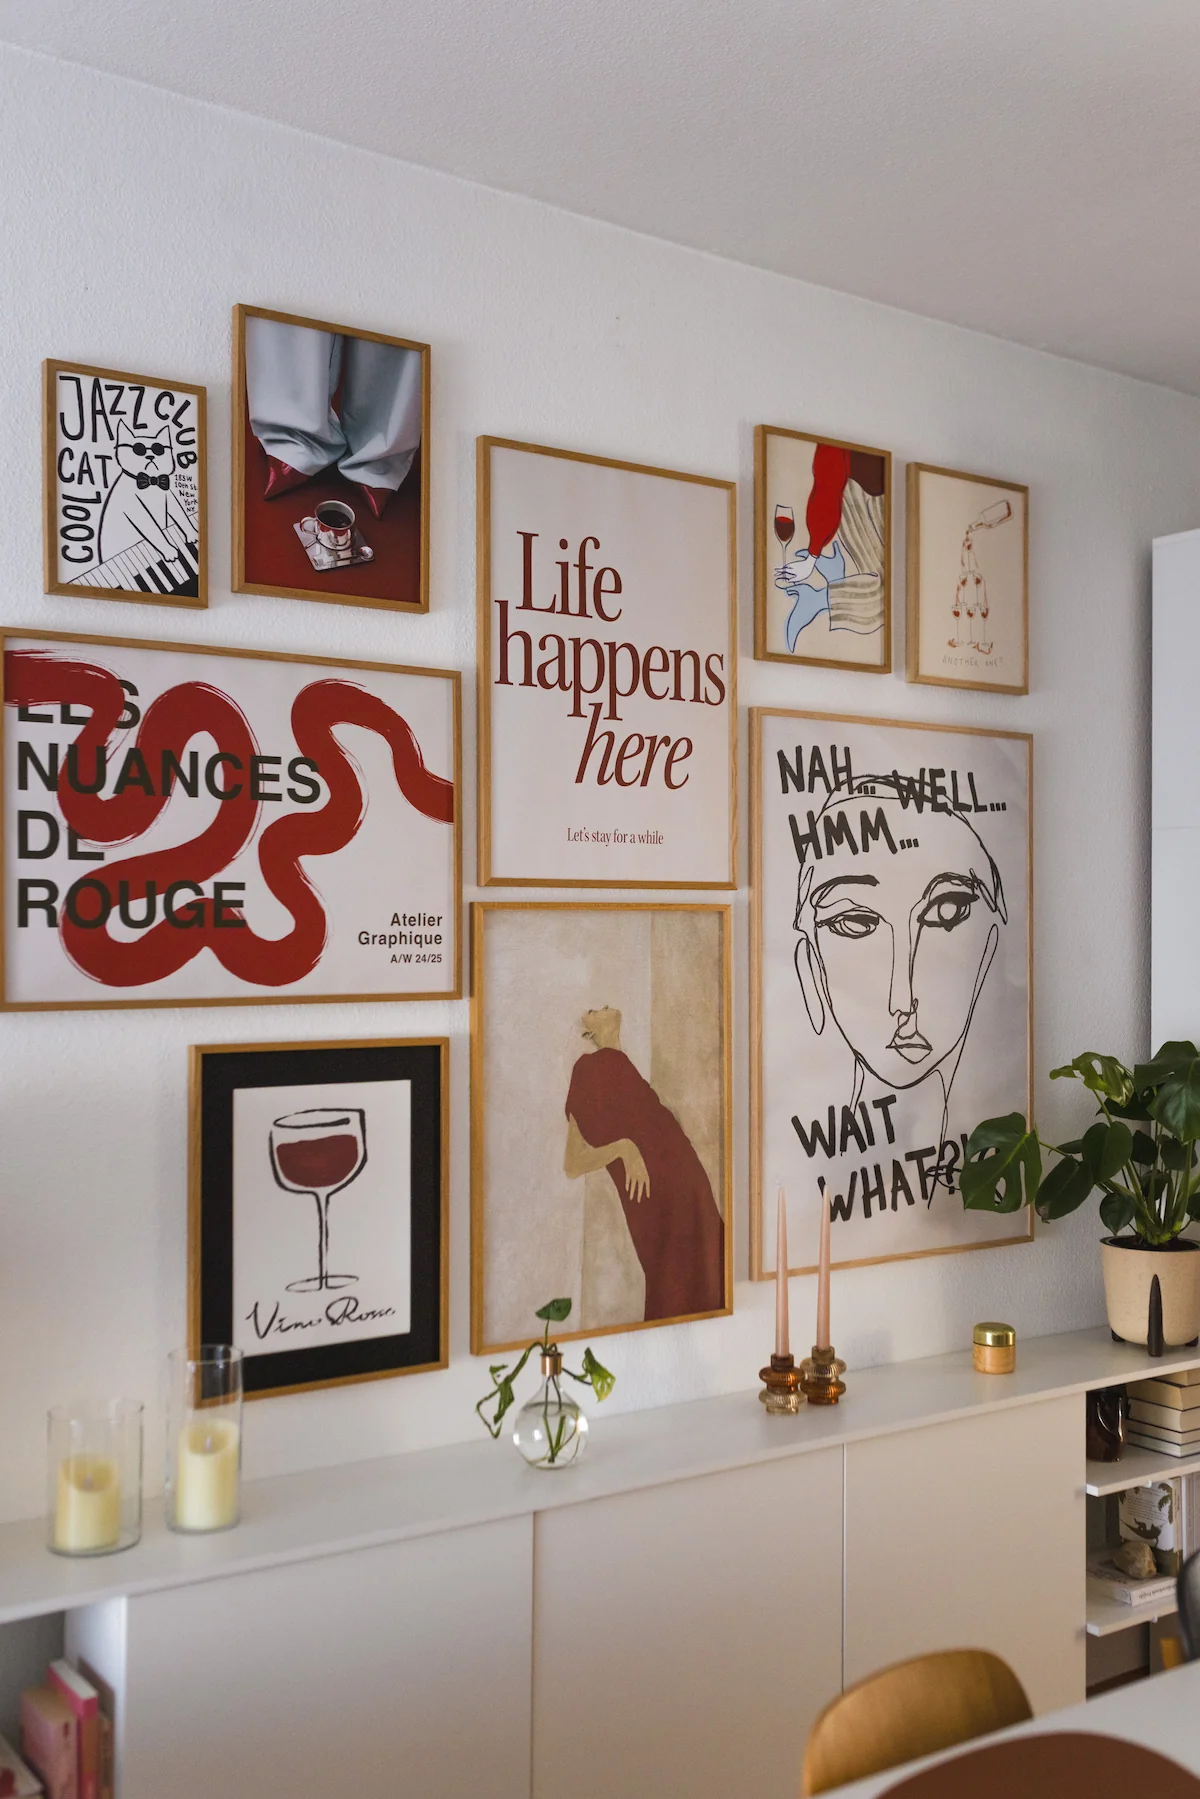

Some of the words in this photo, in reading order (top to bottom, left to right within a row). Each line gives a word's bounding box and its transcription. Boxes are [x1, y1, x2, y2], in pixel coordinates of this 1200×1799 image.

[59, 375, 149, 443] JAZZ
[154, 391, 198, 469] CLUB
[57, 447, 113, 489] CAT
[179, 490, 195, 498] New
[60, 491, 102, 563] COOL
[183, 498, 198, 506] York
[515, 530, 623, 622] Life
[494, 600, 726, 721] happens
[17, 741, 321, 804] NUANCES
[575, 702, 694, 790] here
[777, 745, 876, 795] NAH...
[892, 767, 1007, 814] WELL...
[567, 827, 590, 842] Let's
[591, 830, 611, 847] stay
[613, 829, 628, 844] for
[629, 833, 636, 844] a
[638, 830, 664, 845] while
[788, 807, 919, 864] HMM...
[17, 878, 246, 929] ROUGE
[390, 912, 443, 927] Atelier
[358, 930, 443, 949] Graphique
[390, 953, 413, 964] A/W
[415, 953, 443, 964] 24/25
[791, 1094, 897, 1159] WAIT
